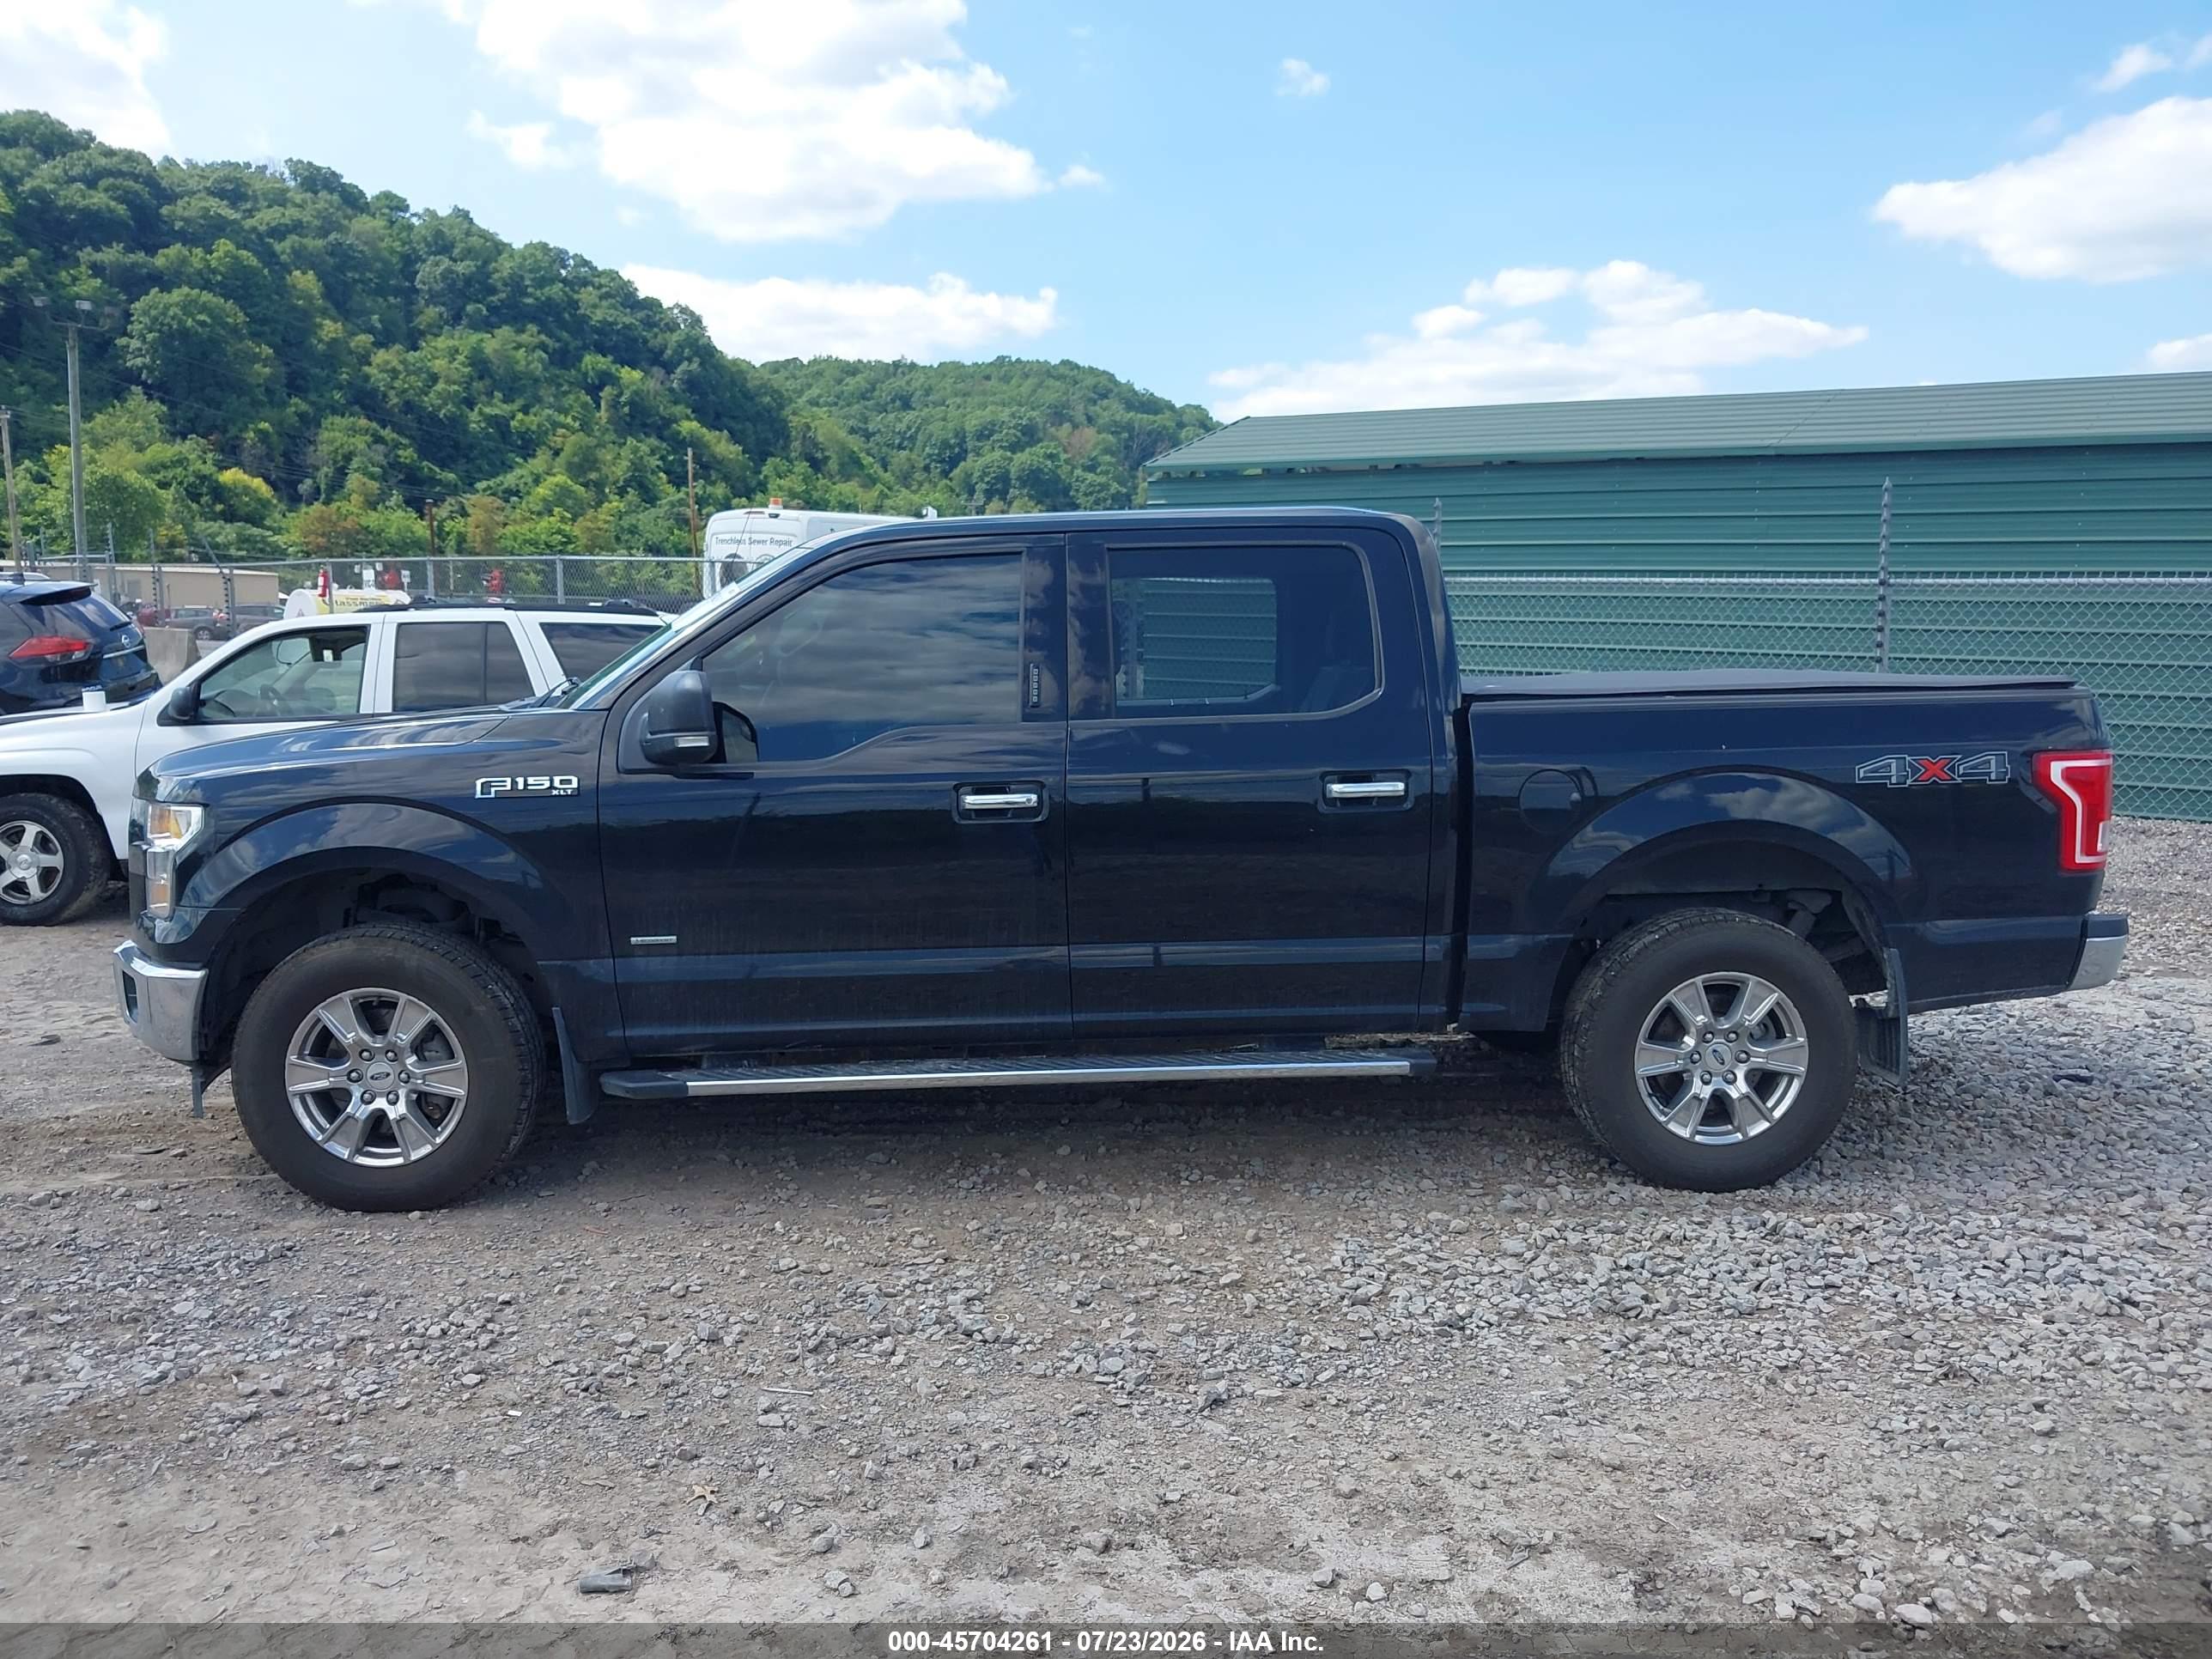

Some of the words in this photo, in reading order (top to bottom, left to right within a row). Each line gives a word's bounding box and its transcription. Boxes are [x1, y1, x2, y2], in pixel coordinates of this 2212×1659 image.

[715, 537, 746, 545] Trenchless
[748, 537, 768, 545] Sewer
[769, 537, 793, 548] Repair
